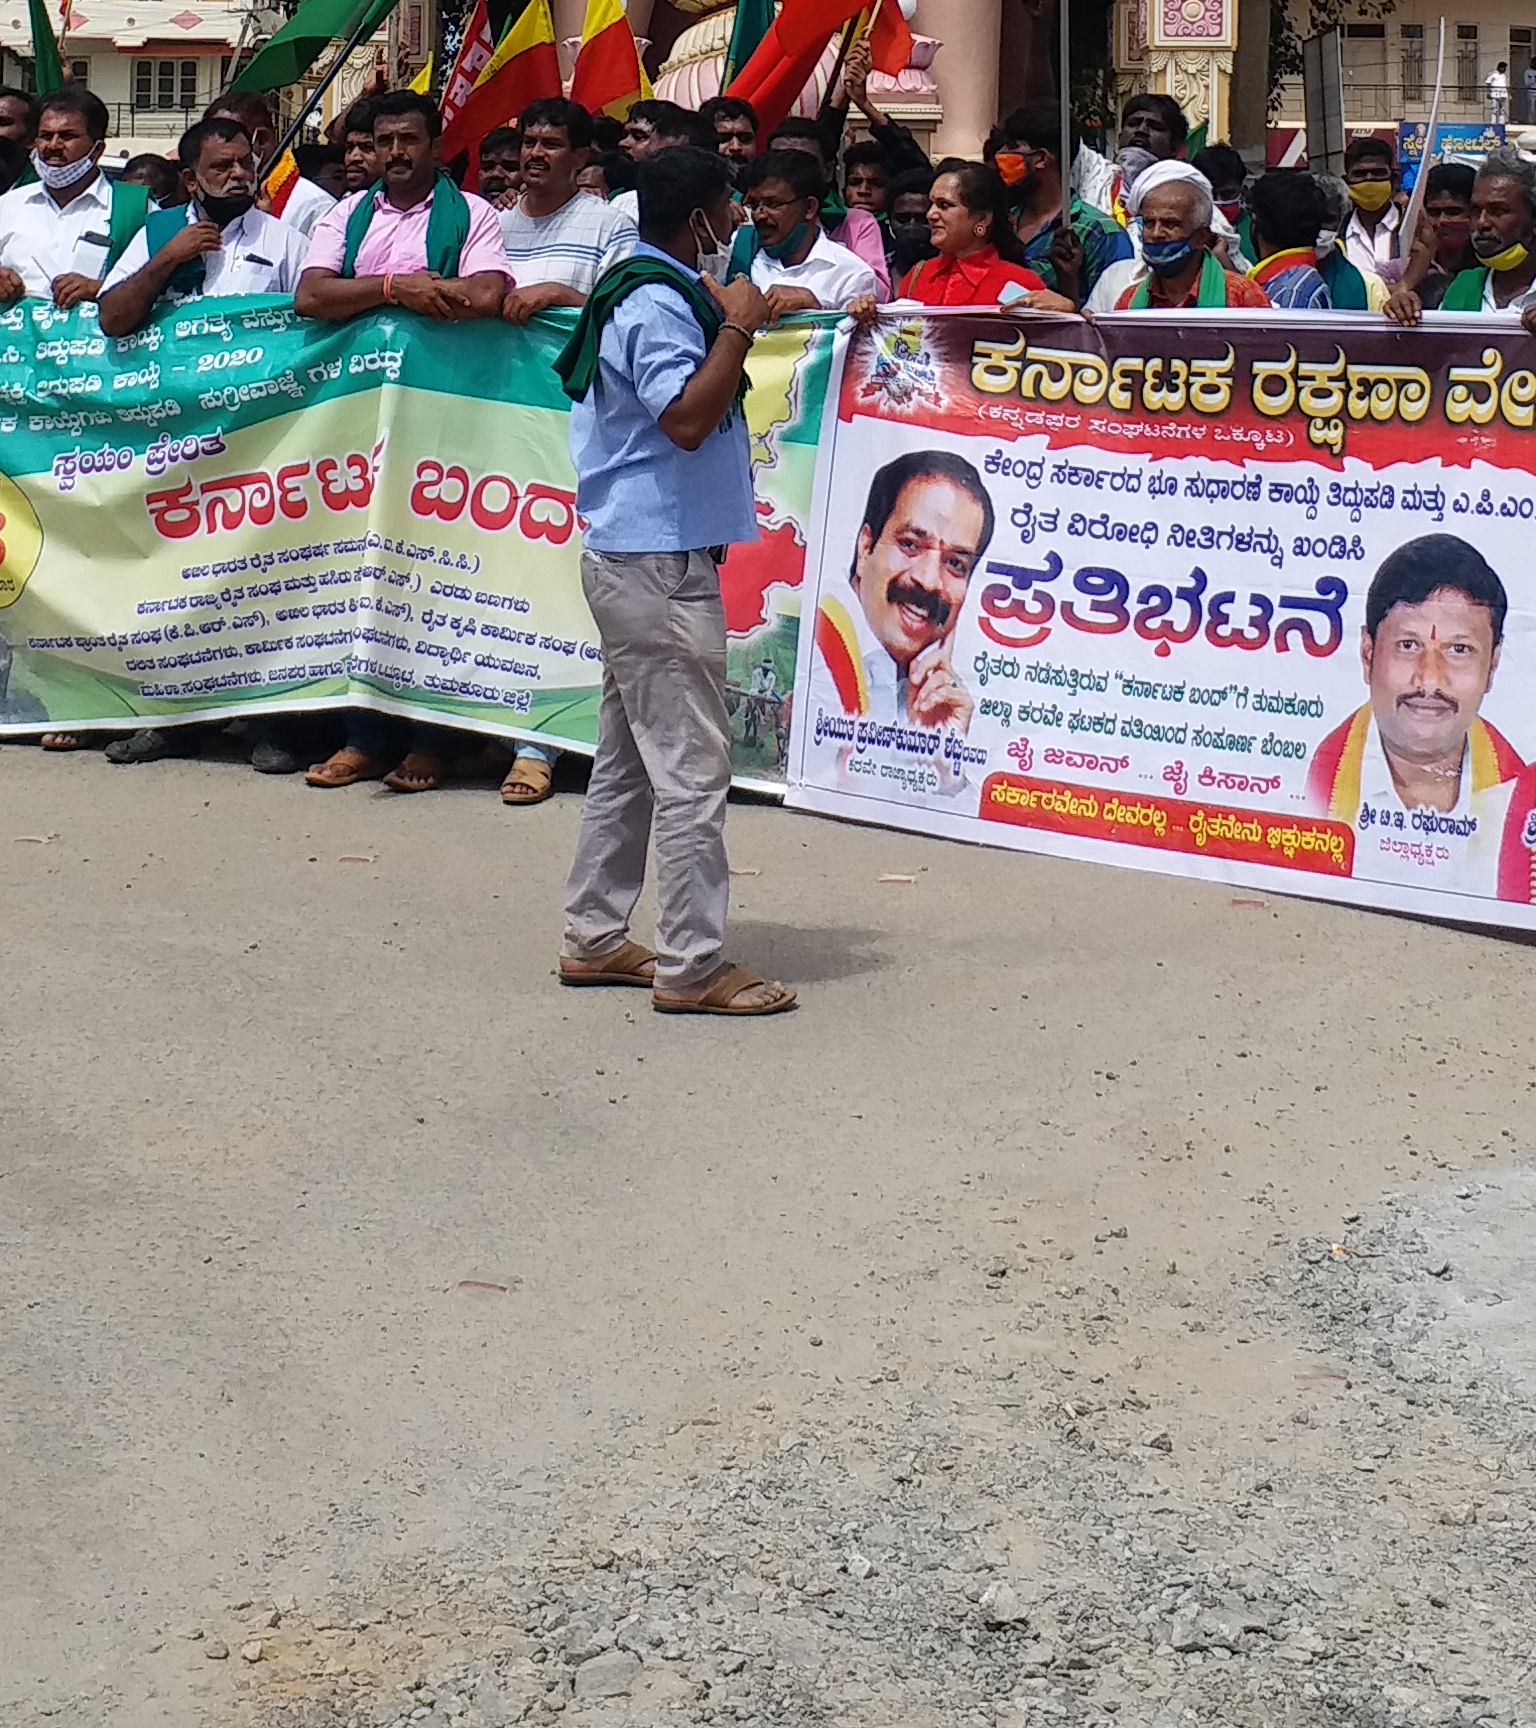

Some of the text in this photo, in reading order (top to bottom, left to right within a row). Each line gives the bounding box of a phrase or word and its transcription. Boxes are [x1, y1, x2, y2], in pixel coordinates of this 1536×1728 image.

[35, 334, 105, 365] ತಿದ್ದುಪಡಿ
[175, 312, 234, 342] ಅಗತ್ಯ
[196, 346, 264, 374] 2020
[970, 326, 1237, 414] ಕರ್ನಾಟಕ
[1251, 342, 1432, 456] ರಕ್ಷಣಾ
[1087, 414, 1208, 442] ಸಂಘಟನೆಗಳ
[54, 428, 227, 492] ಸ್ವಯಂ ಪ್ರೇರಿತ
[983, 449, 1043, 491] ಕೇಂದ್ರ
[1049, 461, 1143, 495] ಸರ್ಕಾರದ
[1147, 473, 1178, 498] ಭೂ
[1184, 473, 1263, 504] ಸುಧಾರಣೆ
[1268, 476, 1321, 521] ಕಾಯ್ದೆ
[1325, 480, 1395, 523] ತಿದ್ದುಪಡಿ
[1400, 489, 1447, 525] ಮತ್ತು
[250, 553, 275, 575] ರೈತ
[277, 543, 330, 565] ಸಂಘರ್ಷ
[1009, 502, 1365, 569] ರೈತ ವಿರೋಧಿ ನೀತಿಗಳನ್ನು ಖಂಡಿಸಿ
[137, 596, 188, 617] ಕರ್ನಾಟಕ
[248, 580, 281, 600] ಸಂಘ
[284, 573, 318, 596] ಮತ್ತು
[430, 580, 472, 600] ಎರಡು
[977, 549, 1349, 658] ಪ್ರತಿಭಟನೆ
[131, 626, 162, 646] ಸಂಘ
[421, 607, 447, 634] ರೈತ
[480, 621, 536, 647] ಕಾರ್ಮಿಕ
[423, 673, 500, 700] ತುಮಕೂರು
[973, 650, 1021, 686] ರೈತರು
[1024, 661, 1110, 698] ನಡೆಸುತ್ತಿರುವ
[1251, 689, 1325, 719] ತುಮಕೂರು
[814, 708, 855, 746] ಶ್ರೀಯುತ
[979, 697, 1307, 761] ಜಿಲ್ಲಾ ಕರವೇ ಘಟಕದ ವತಿಯಿಂದ ಸಂಪೂರ್ಣ ಬೆಂಬಲ
[848, 756, 877, 777] ಕರವೇ
[1006, 736, 1282, 796] ಜೈ ಜವಾನ್ ಜೈ ಕಿಸಾನ್
[990, 779, 1346, 864] ಸರ್ಕಾರವೇನು ದೇವರಲ್ಲ ರೈತನೇನು ಭಿಕ್ಷುಕನಲ್ಲ
[1358, 801, 1378, 833] ಶ್ರೀ
[1411, 810, 1478, 838] ರಘುರಾಮ್
[1378, 836, 1451, 868] ಜಿಲ್ಲಾಧ್ಯಕ್ಷರು
